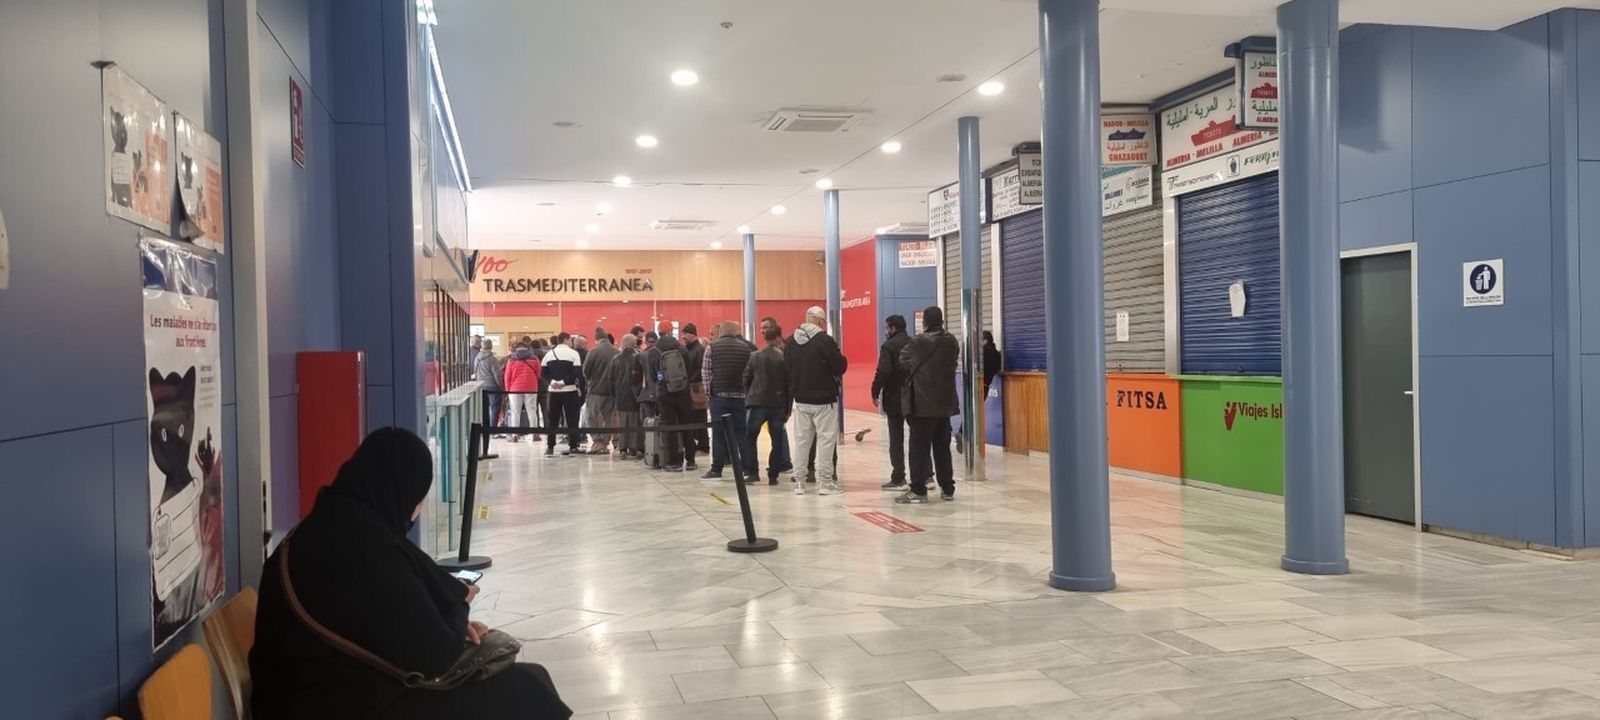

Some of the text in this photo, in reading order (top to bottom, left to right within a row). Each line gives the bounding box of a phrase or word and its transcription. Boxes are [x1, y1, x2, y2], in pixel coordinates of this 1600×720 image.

[1196, 143, 1223, 158] MELILLA
[483, 278, 653, 293] TRASMEDITERRANEA
[150, 314, 161, 328] Les
[1117, 390, 1167, 410] FITSA
[1238, 402, 1268, 420] Viajes
